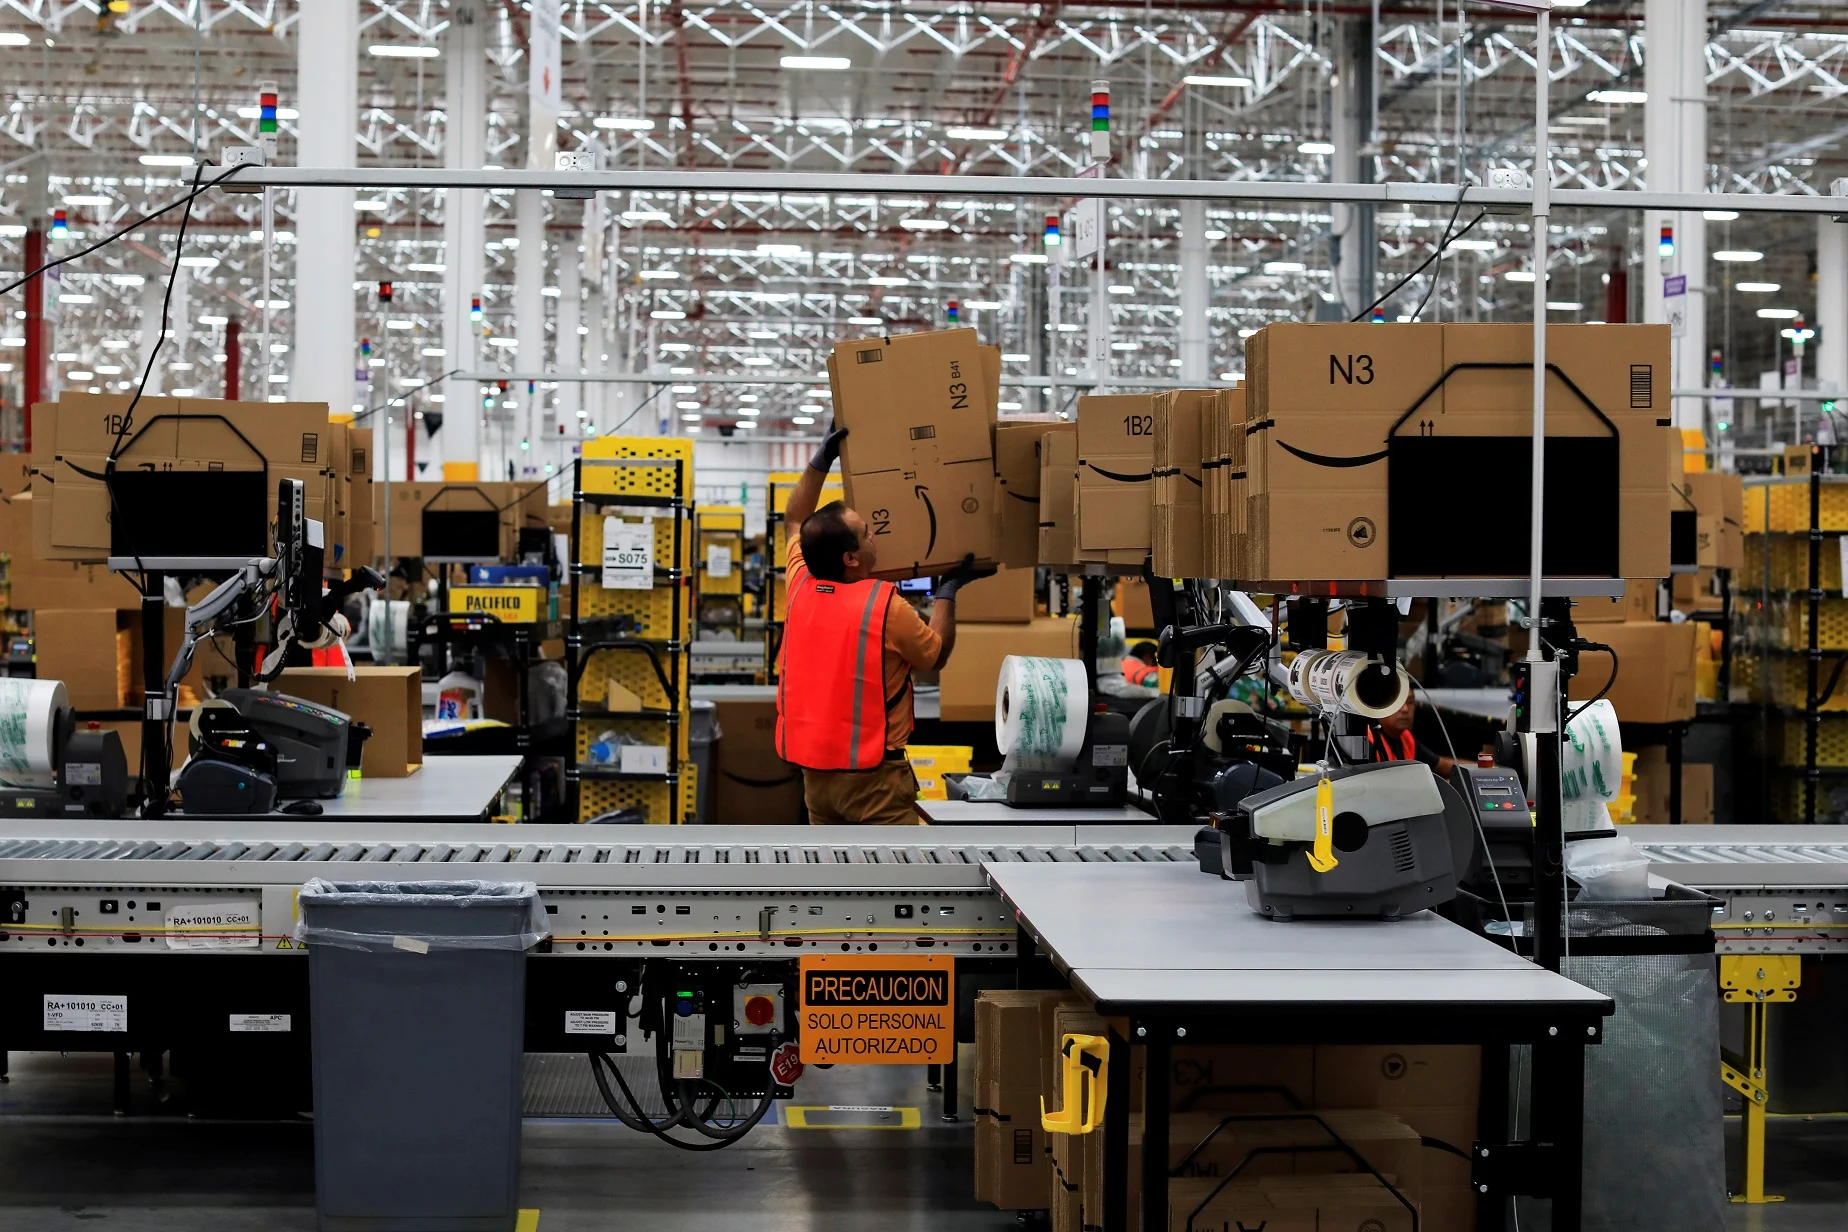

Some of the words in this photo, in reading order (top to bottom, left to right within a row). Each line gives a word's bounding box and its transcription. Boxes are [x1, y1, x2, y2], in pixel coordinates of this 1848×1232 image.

[950, 360, 961, 379] B41
[1330, 354, 1374, 385] N3
[949, 382, 969, 410] N3
[103, 414, 133, 436] 1B2
[1123, 415, 1153, 436] 1B2
[872, 508, 891, 535] N3
[618, 553, 648, 564] S075
[466, 595, 521, 611] PACIFICO
[811, 976, 942, 1001] PRECAUCION
[100, 1003, 123, 1011] CC+01
[808, 1013, 853, 1030] SOLO
[857, 1013, 946, 1030] PERSONAL
[815, 1037, 938, 1054] AUTORIZADO
[777, 1053, 799, 1077] E19
[1174, 1059, 1213, 1086] K3
